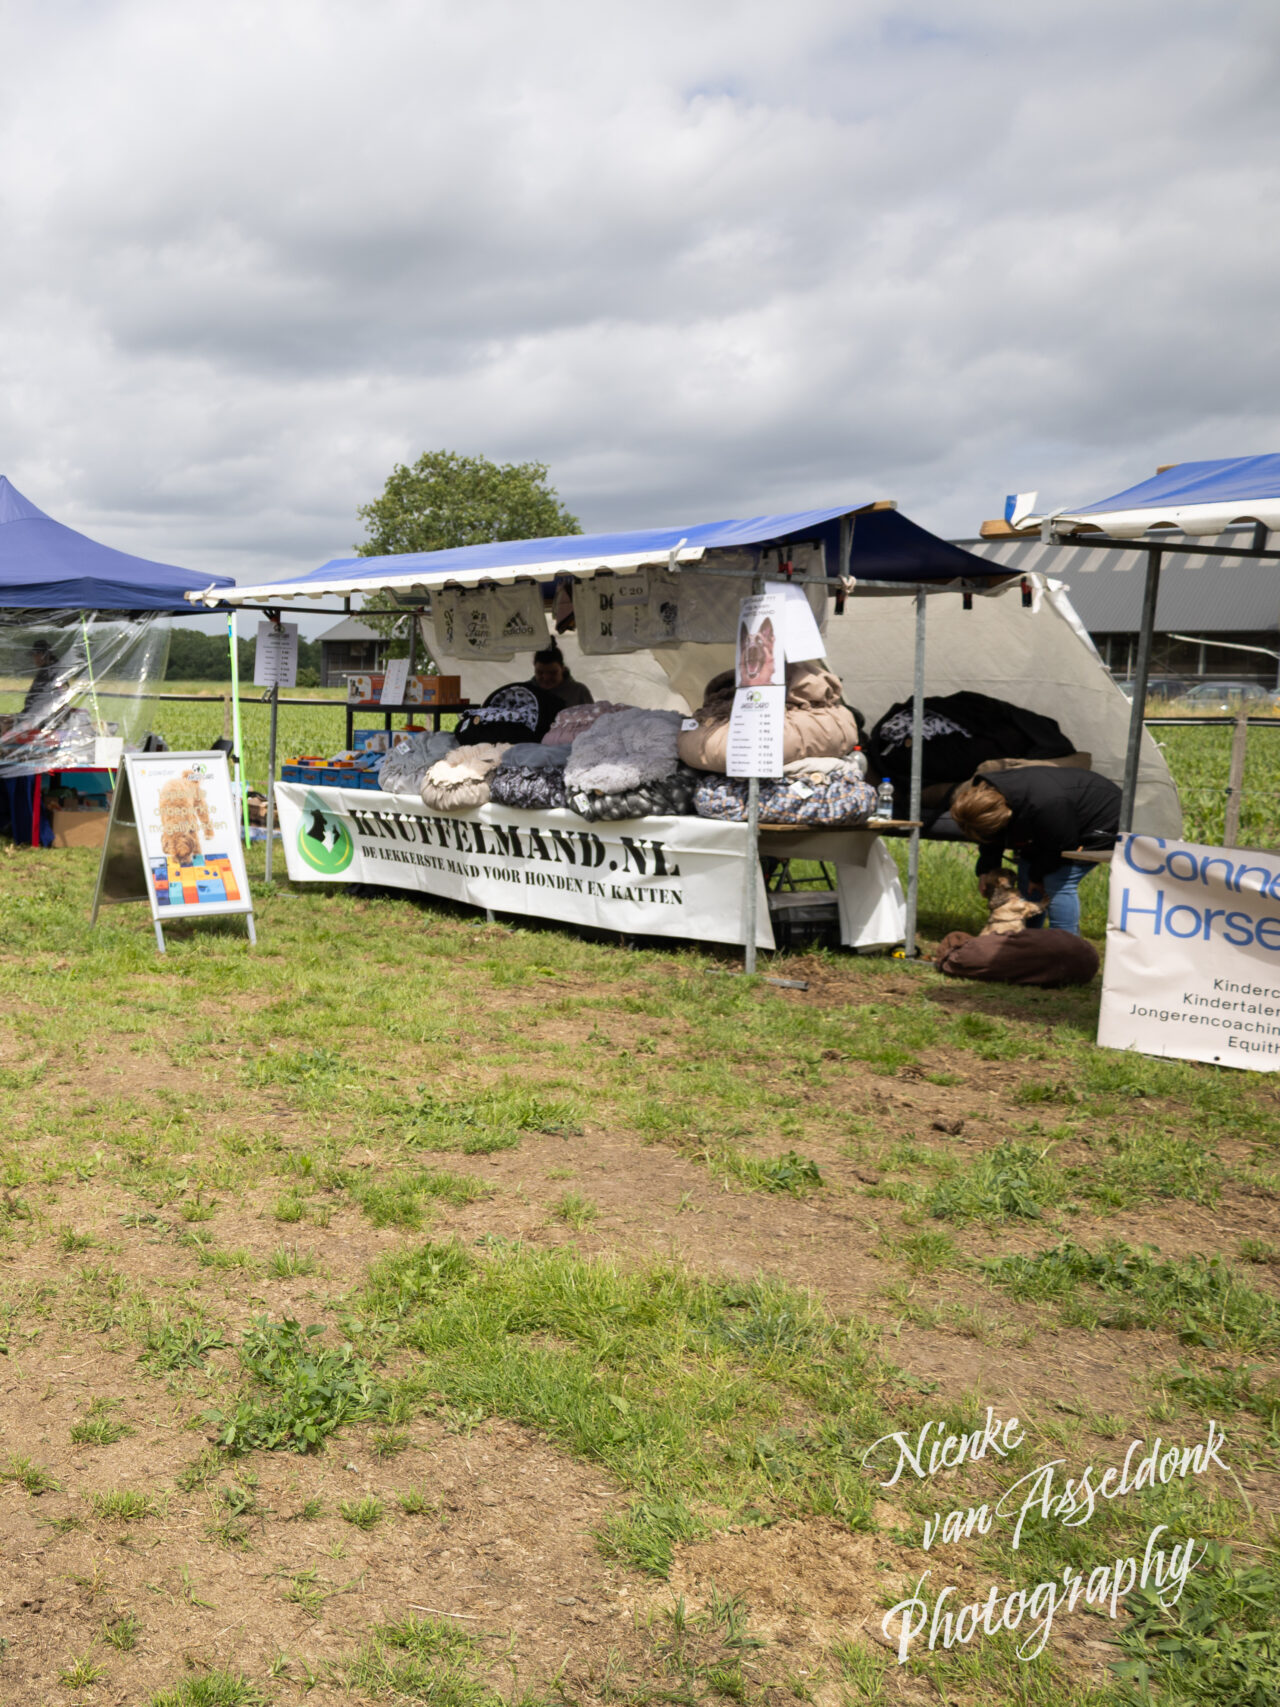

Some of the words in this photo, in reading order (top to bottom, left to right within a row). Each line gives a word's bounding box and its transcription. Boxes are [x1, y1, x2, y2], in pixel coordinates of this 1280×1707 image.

[347, 809, 681, 877] KNUFFELMAND.NL
[362, 845, 378, 859] DE
[378, 847, 445, 872] LEKKERSTE
[447, 859, 480, 878] MAND
[483, 866, 521, 884] VOOR
[525, 871, 583, 894] HONDEN
[588, 880, 606, 898] EN
[611, 884, 683, 905] KATTEN
